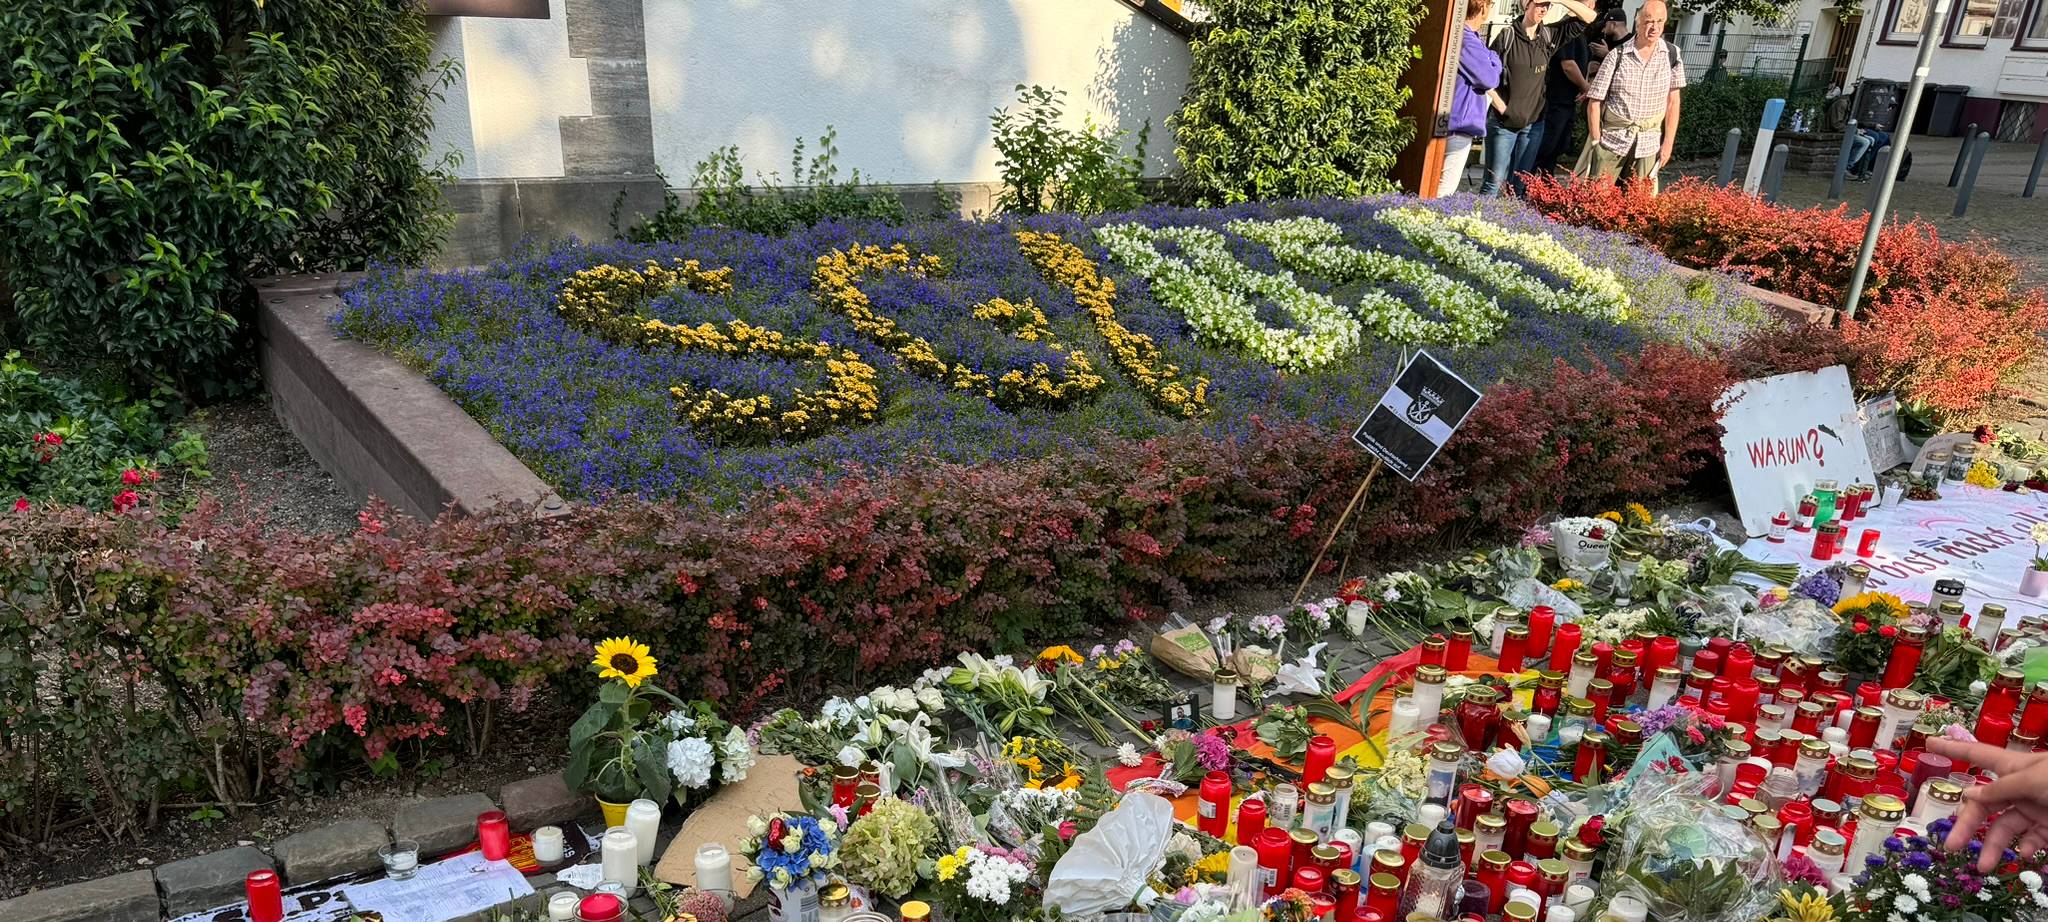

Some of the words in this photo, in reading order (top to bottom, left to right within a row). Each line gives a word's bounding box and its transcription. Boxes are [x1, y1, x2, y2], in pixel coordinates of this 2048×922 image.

[1450, 24, 1461, 54] ZUGANG
[1456, 7, 1464, 24] ZUM
[1382, 447, 1408, 468] Deutschland
[1746, 429, 1825, 469] WARUM?
[1854, 549, 1949, 579] bist
[1933, 526, 2025, 559] nicht
